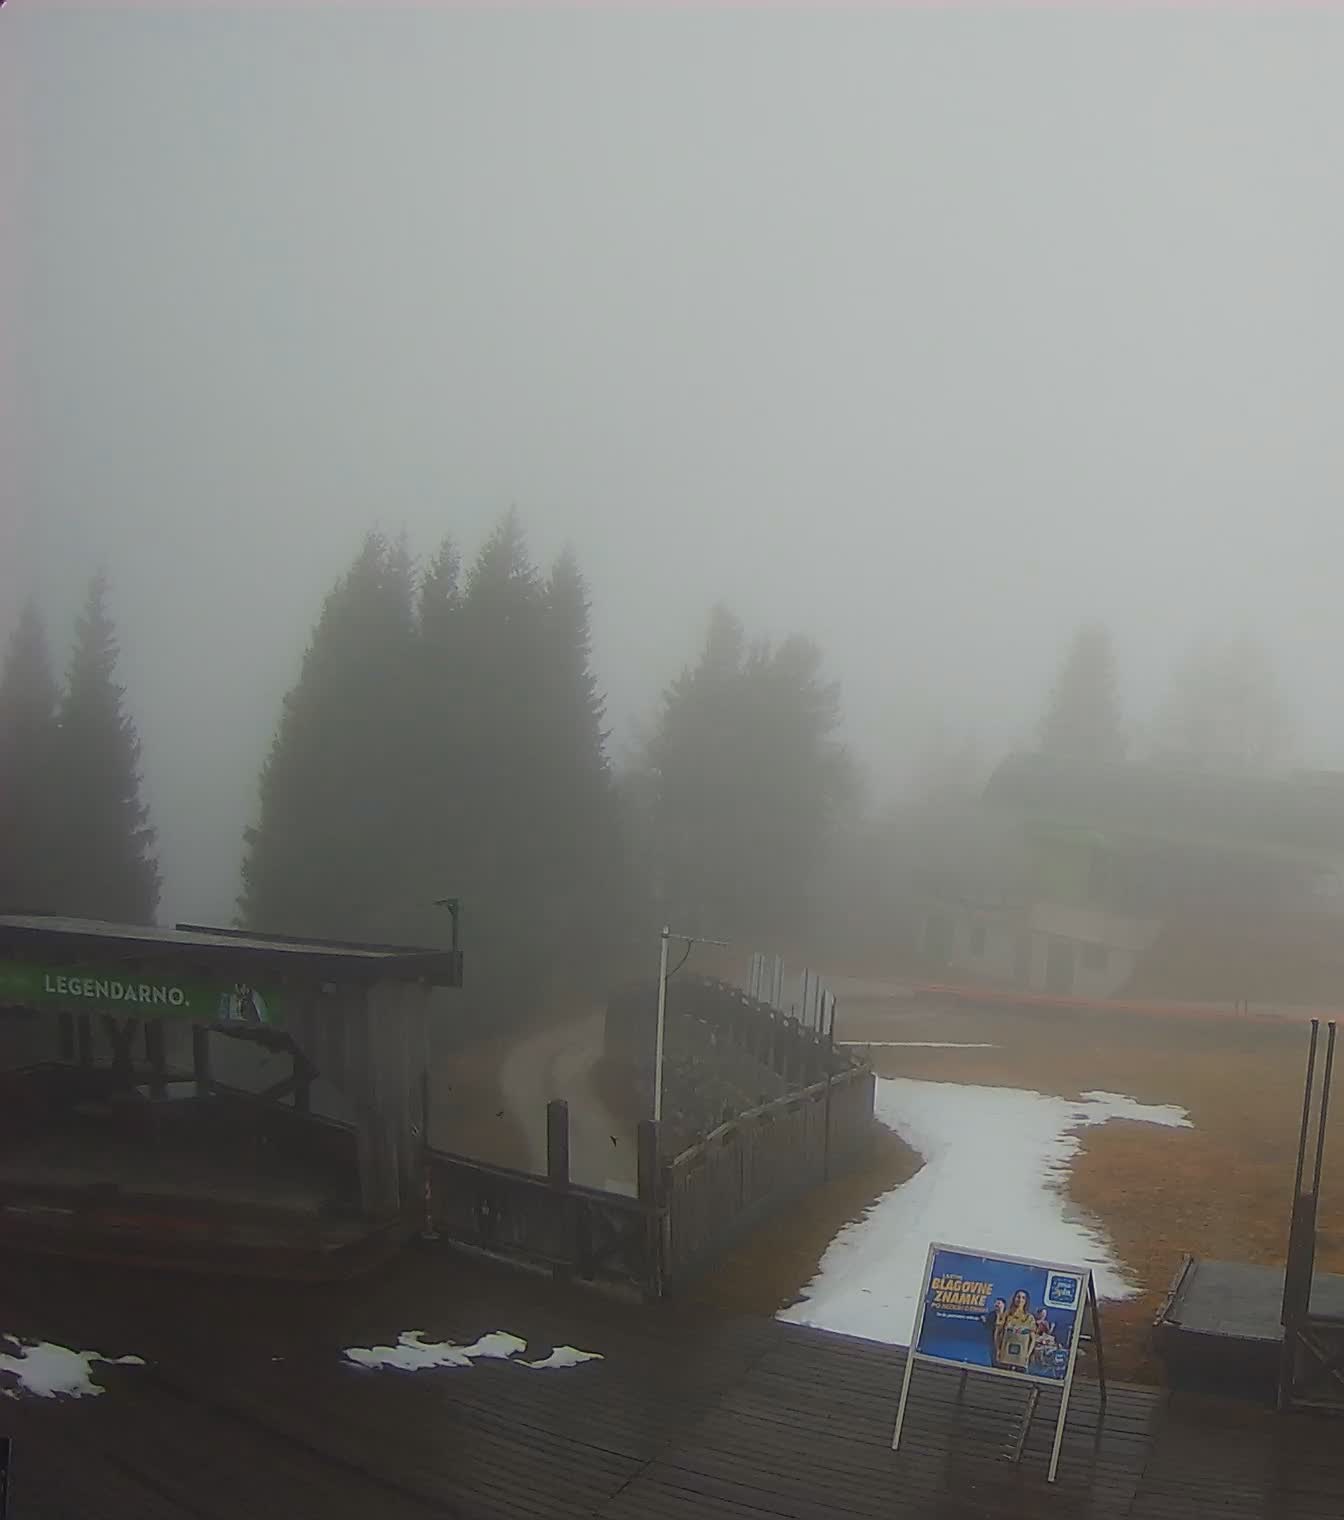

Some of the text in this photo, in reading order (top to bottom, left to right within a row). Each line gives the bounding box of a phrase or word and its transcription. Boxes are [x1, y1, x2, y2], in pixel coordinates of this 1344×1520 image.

[45, 975, 191, 1006] LEGENDARNO.
[931, 1278, 993, 1295] BLAGOVNE
[934, 1291, 987, 1306] ZNAMKE
